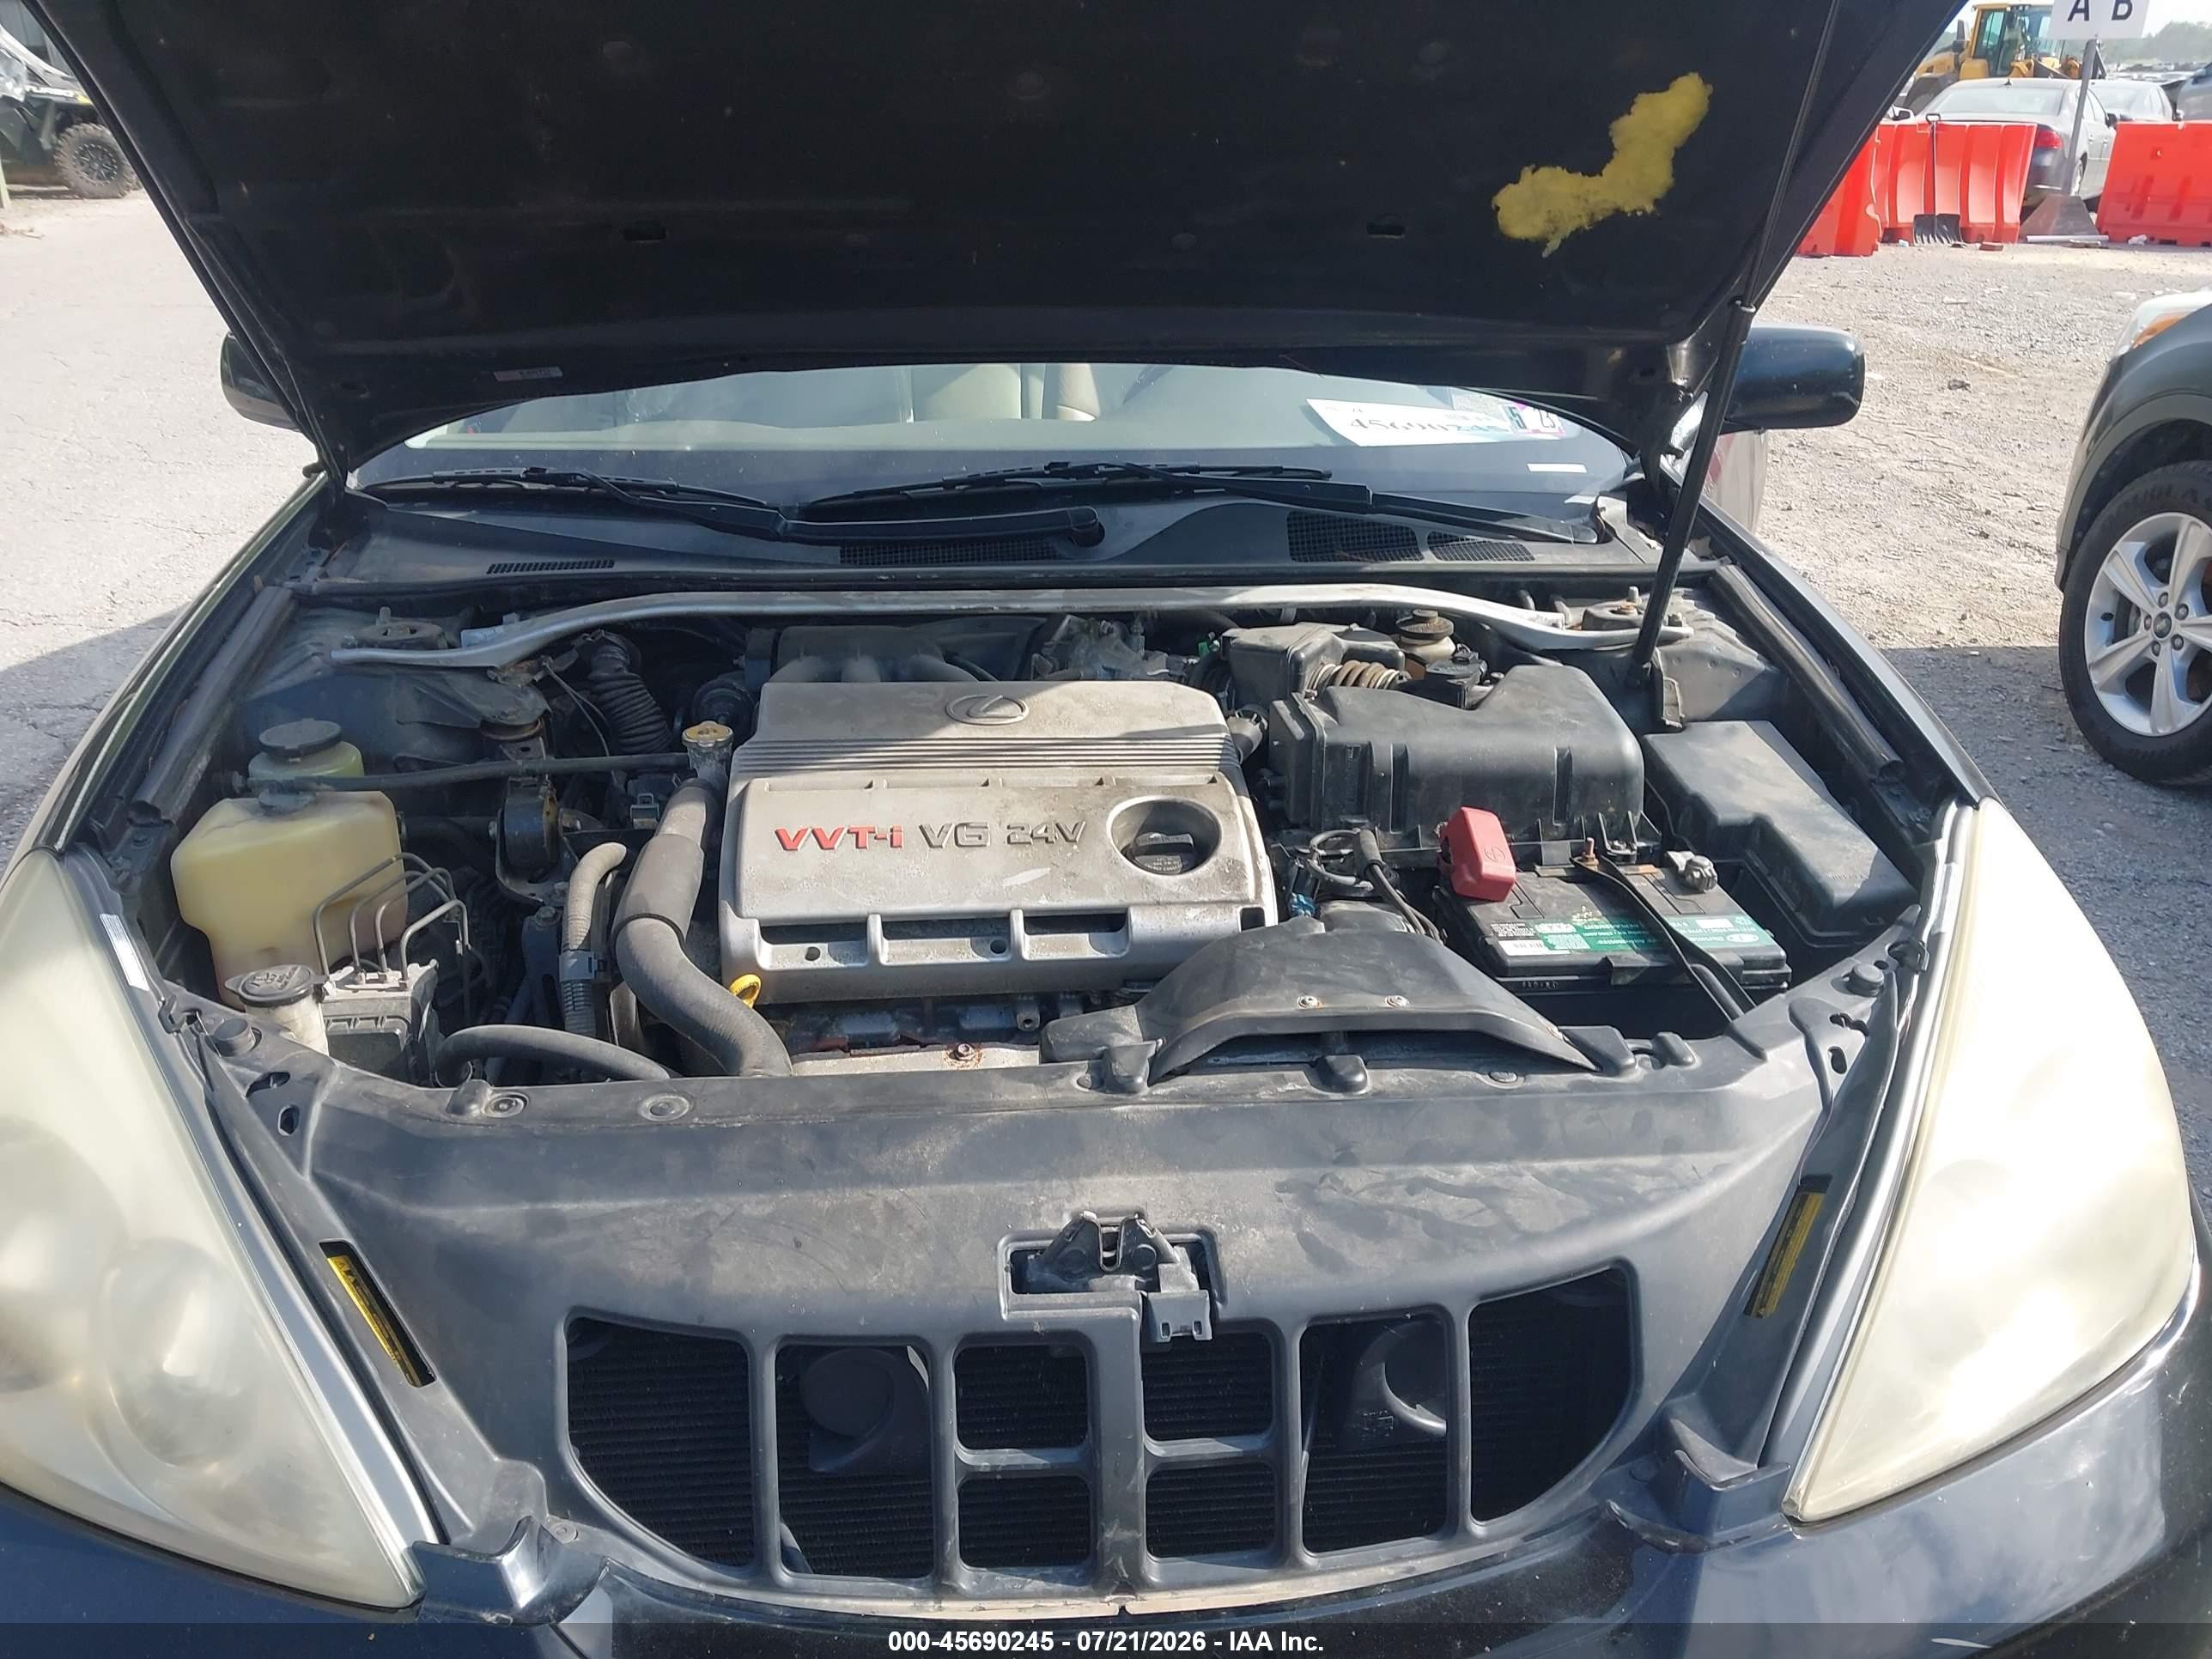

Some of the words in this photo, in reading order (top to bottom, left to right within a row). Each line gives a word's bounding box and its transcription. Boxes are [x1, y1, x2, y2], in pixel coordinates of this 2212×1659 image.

[774, 824, 904, 851] VVT-i
[919, 821, 991, 849] V6
[1006, 819, 1086, 846] 24V
